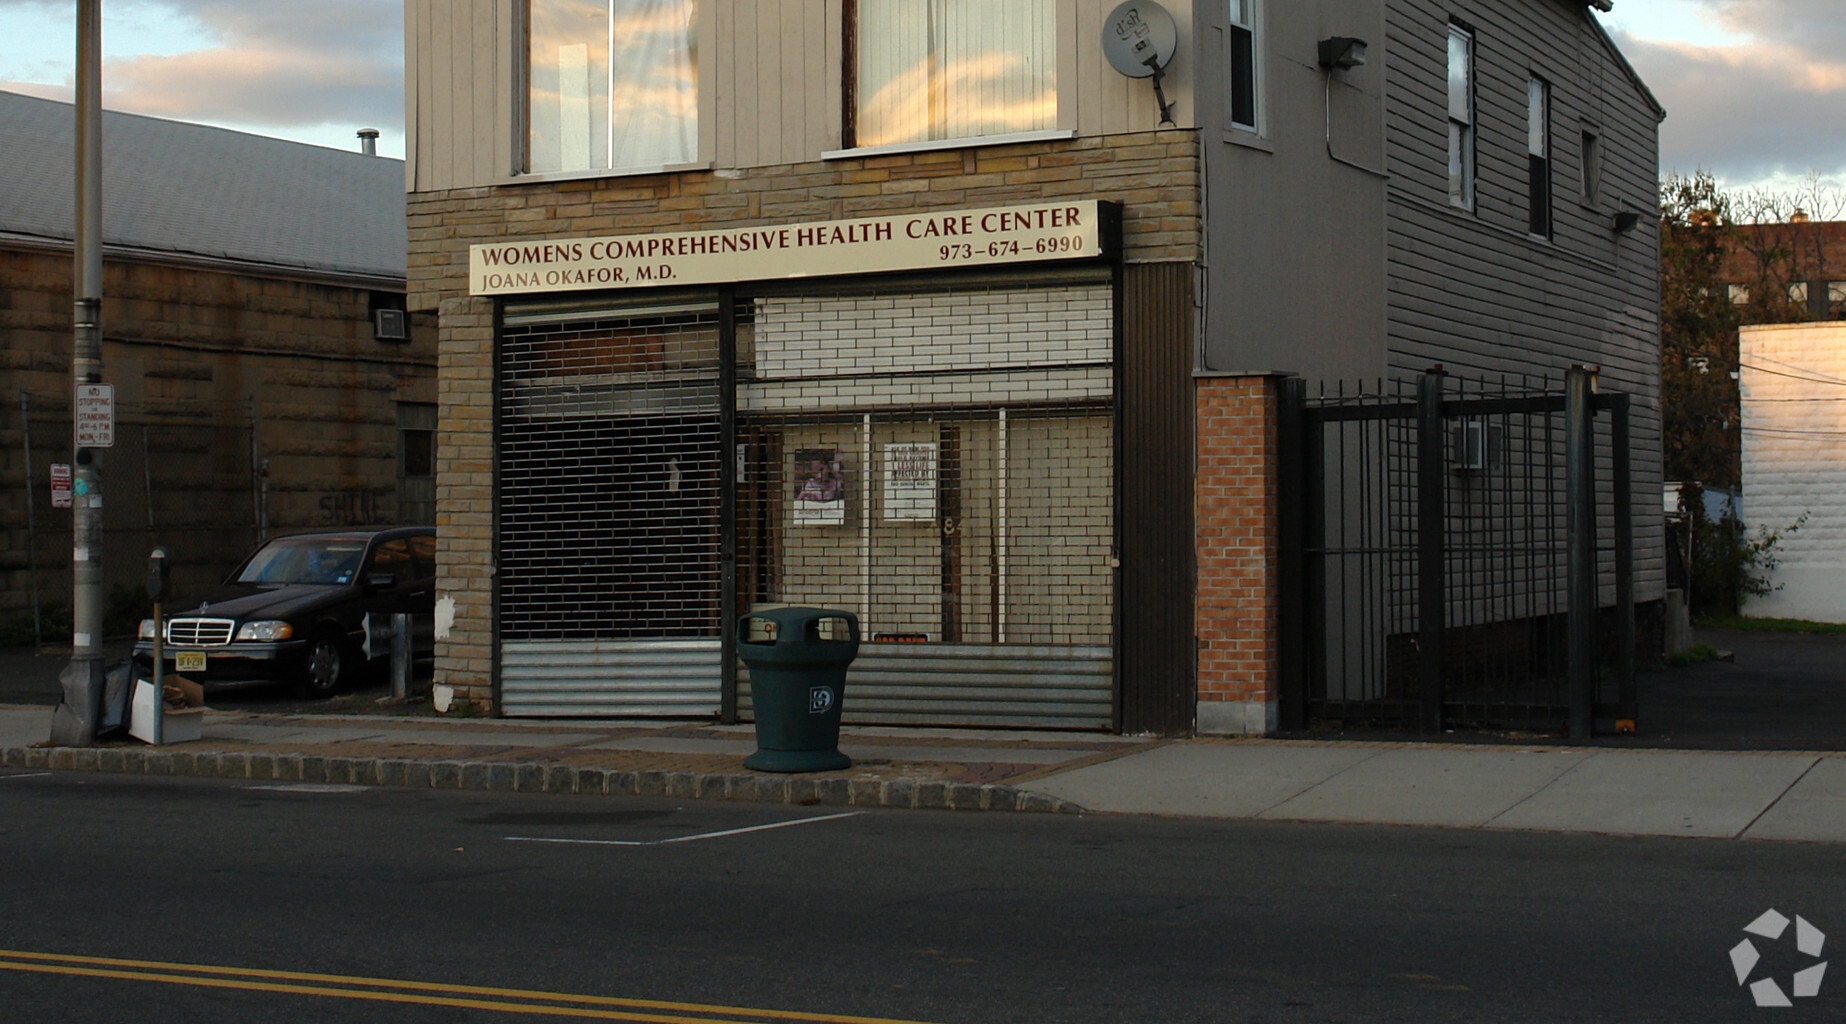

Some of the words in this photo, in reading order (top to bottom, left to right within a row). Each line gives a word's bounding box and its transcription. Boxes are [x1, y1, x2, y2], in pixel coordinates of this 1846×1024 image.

[481, 243, 583, 266] WOMENS
[590, 229, 789, 261] COMPREHENSIVE
[797, 221, 892, 247] HEALTH
[906, 215, 973, 239] CARE
[981, 206, 1082, 233] CENTER
[939, 235, 1083, 261] 973-674-6990
[482, 271, 541, 292] JOANA
[546, 267, 630, 285] OKAFOR,
[636, 263, 677, 281] M.D.
[88, 387, 100, 396] NO
[79, 398, 110, 406] STOPPING
[79, 413, 110, 421] STANDING
